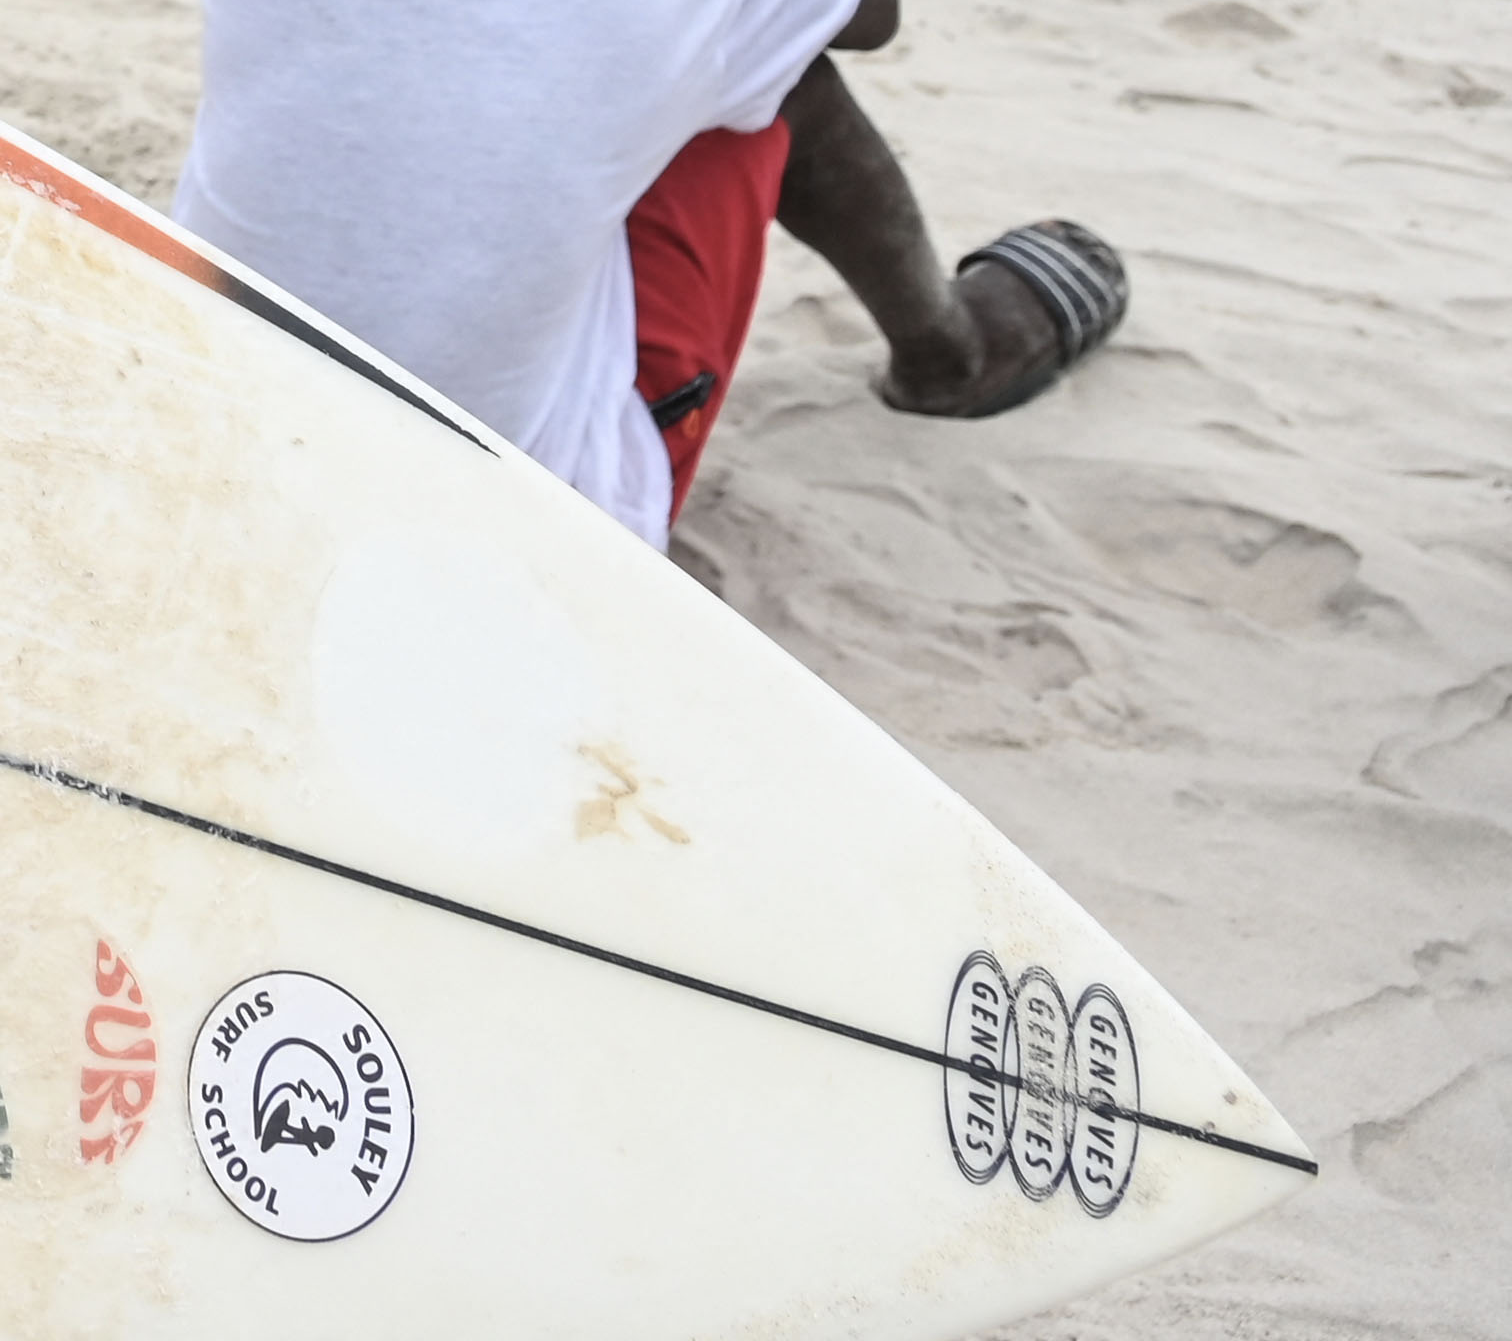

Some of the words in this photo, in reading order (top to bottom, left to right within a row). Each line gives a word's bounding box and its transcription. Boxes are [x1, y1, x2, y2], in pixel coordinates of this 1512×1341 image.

[211, 990, 275, 1064] SURF
[201, 1082, 280, 1216] SCHOOL
[342, 1023, 393, 1198] SOULEY
